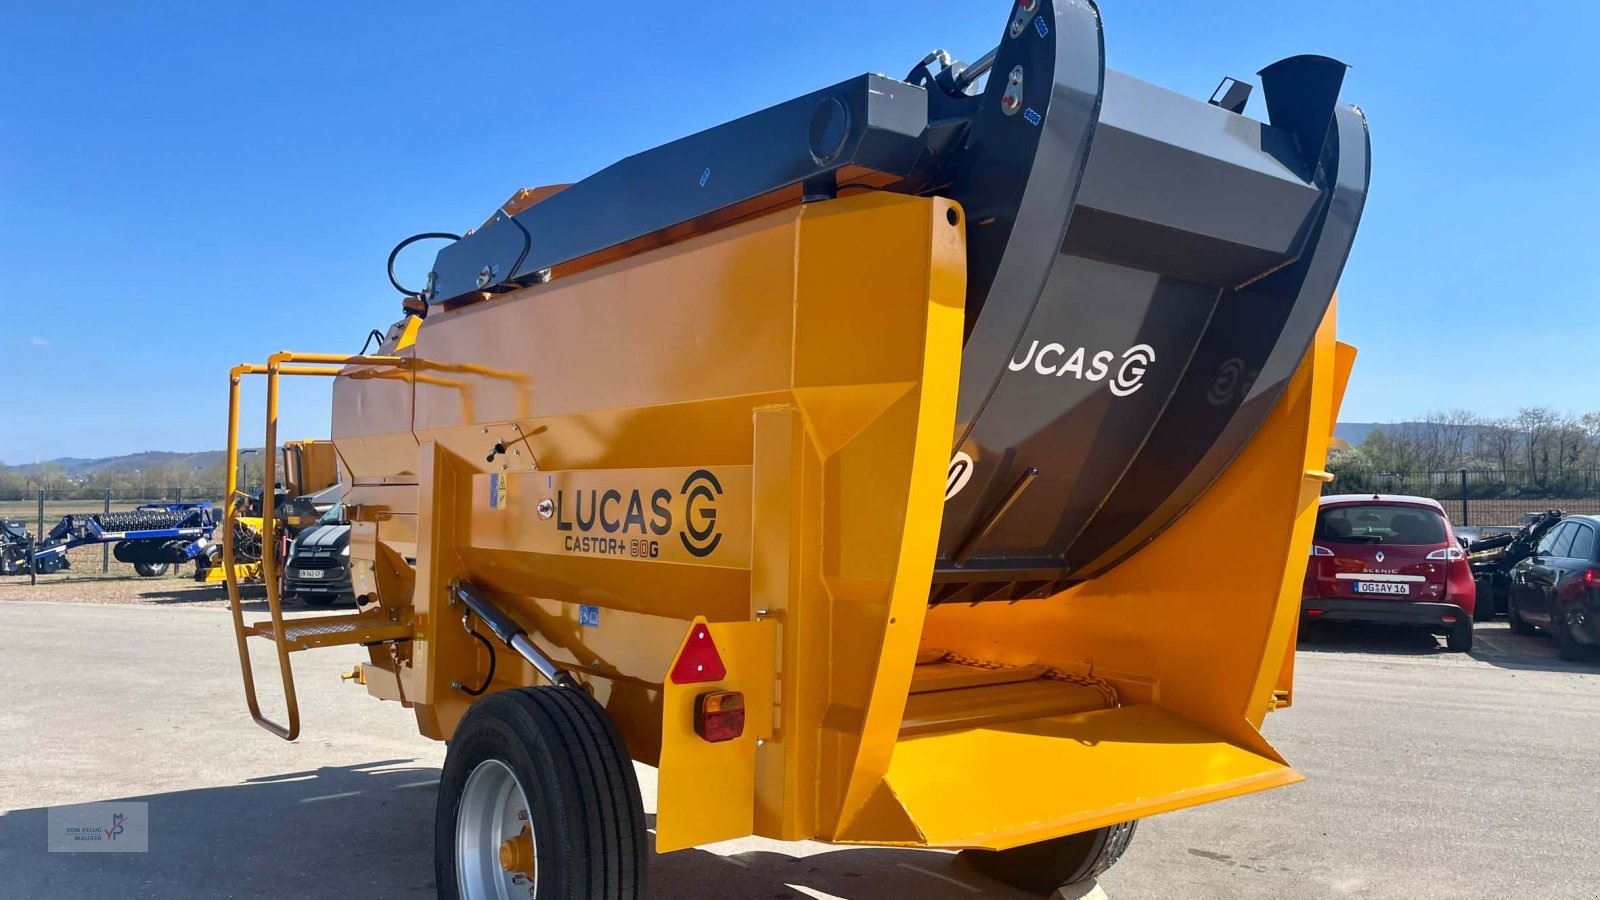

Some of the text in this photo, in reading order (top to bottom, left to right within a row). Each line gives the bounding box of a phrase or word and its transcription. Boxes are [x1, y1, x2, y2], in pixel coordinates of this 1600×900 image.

[557, 488, 673, 536] LUCAS
[565, 535, 659, 558] CASTOR+ 60G
